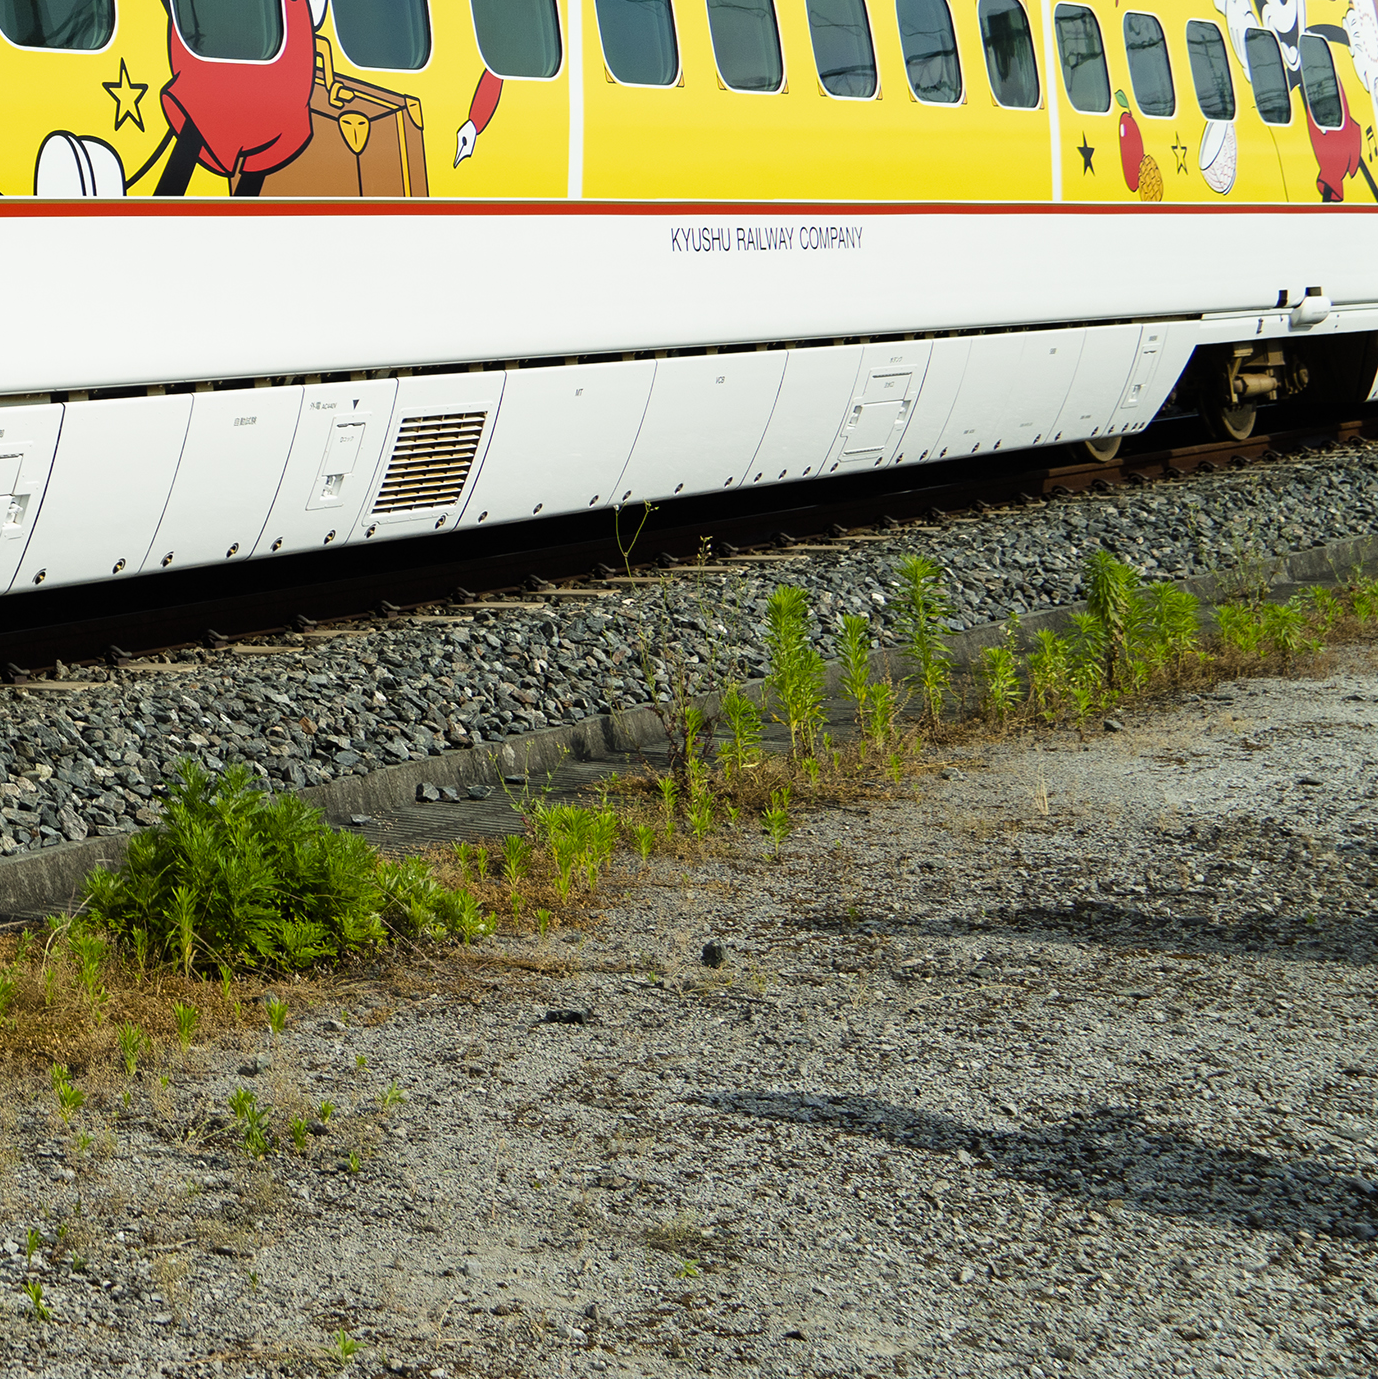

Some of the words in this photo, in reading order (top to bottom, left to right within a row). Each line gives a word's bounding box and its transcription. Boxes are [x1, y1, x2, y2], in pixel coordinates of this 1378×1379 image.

[671, 227, 731, 252] KYUSHU
[736, 227, 794, 251] RAILWAY
[799, 226, 863, 250] COMPANY
